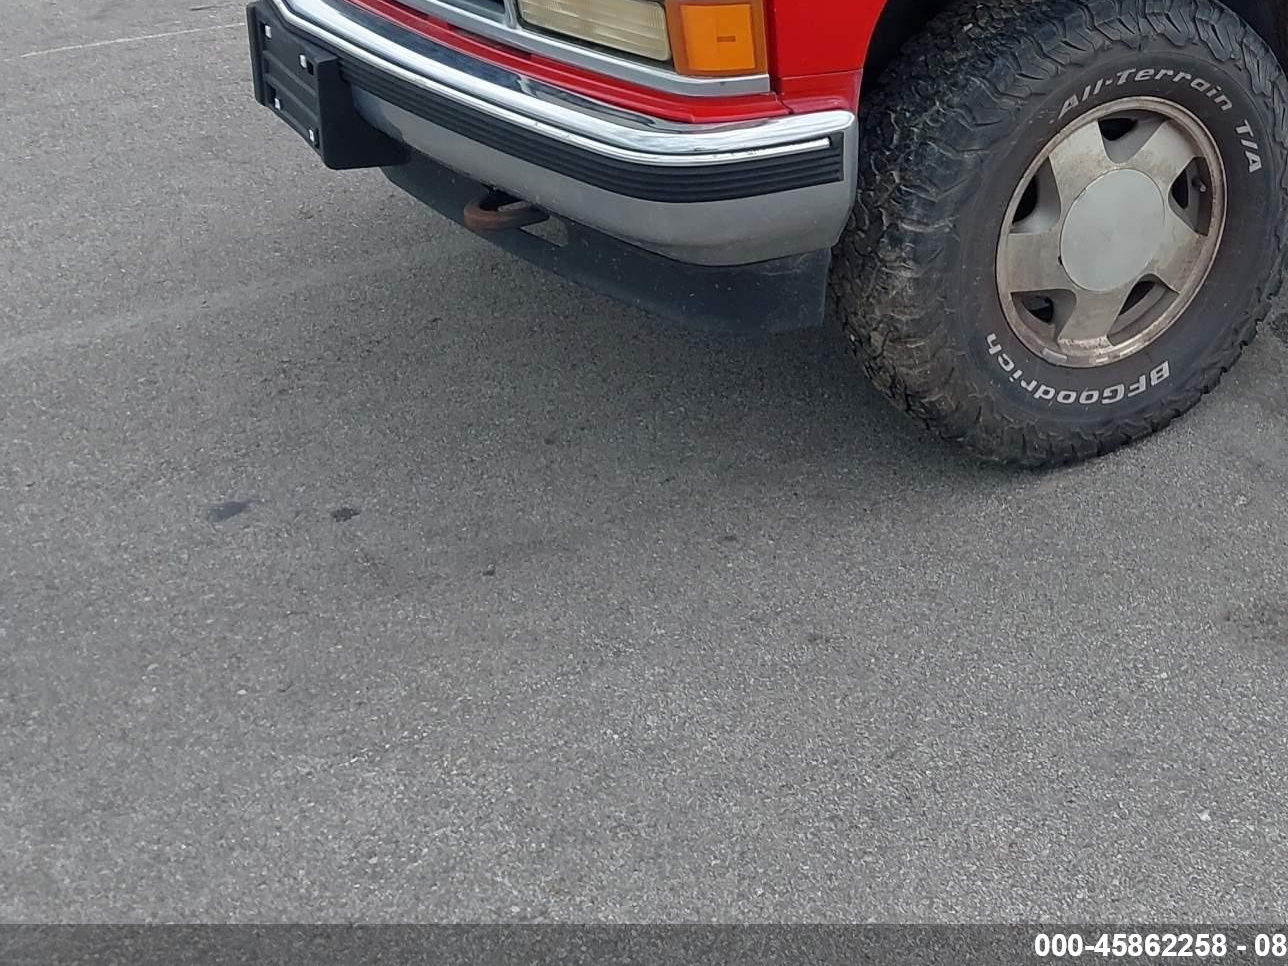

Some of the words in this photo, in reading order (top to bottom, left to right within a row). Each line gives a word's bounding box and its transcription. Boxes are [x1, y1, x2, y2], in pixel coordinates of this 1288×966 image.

[1059, 68, 1233, 119] All-Terrain
[1234, 120, 1263, 173] T/A
[985, 333, 1171, 405] BFGoodrich
